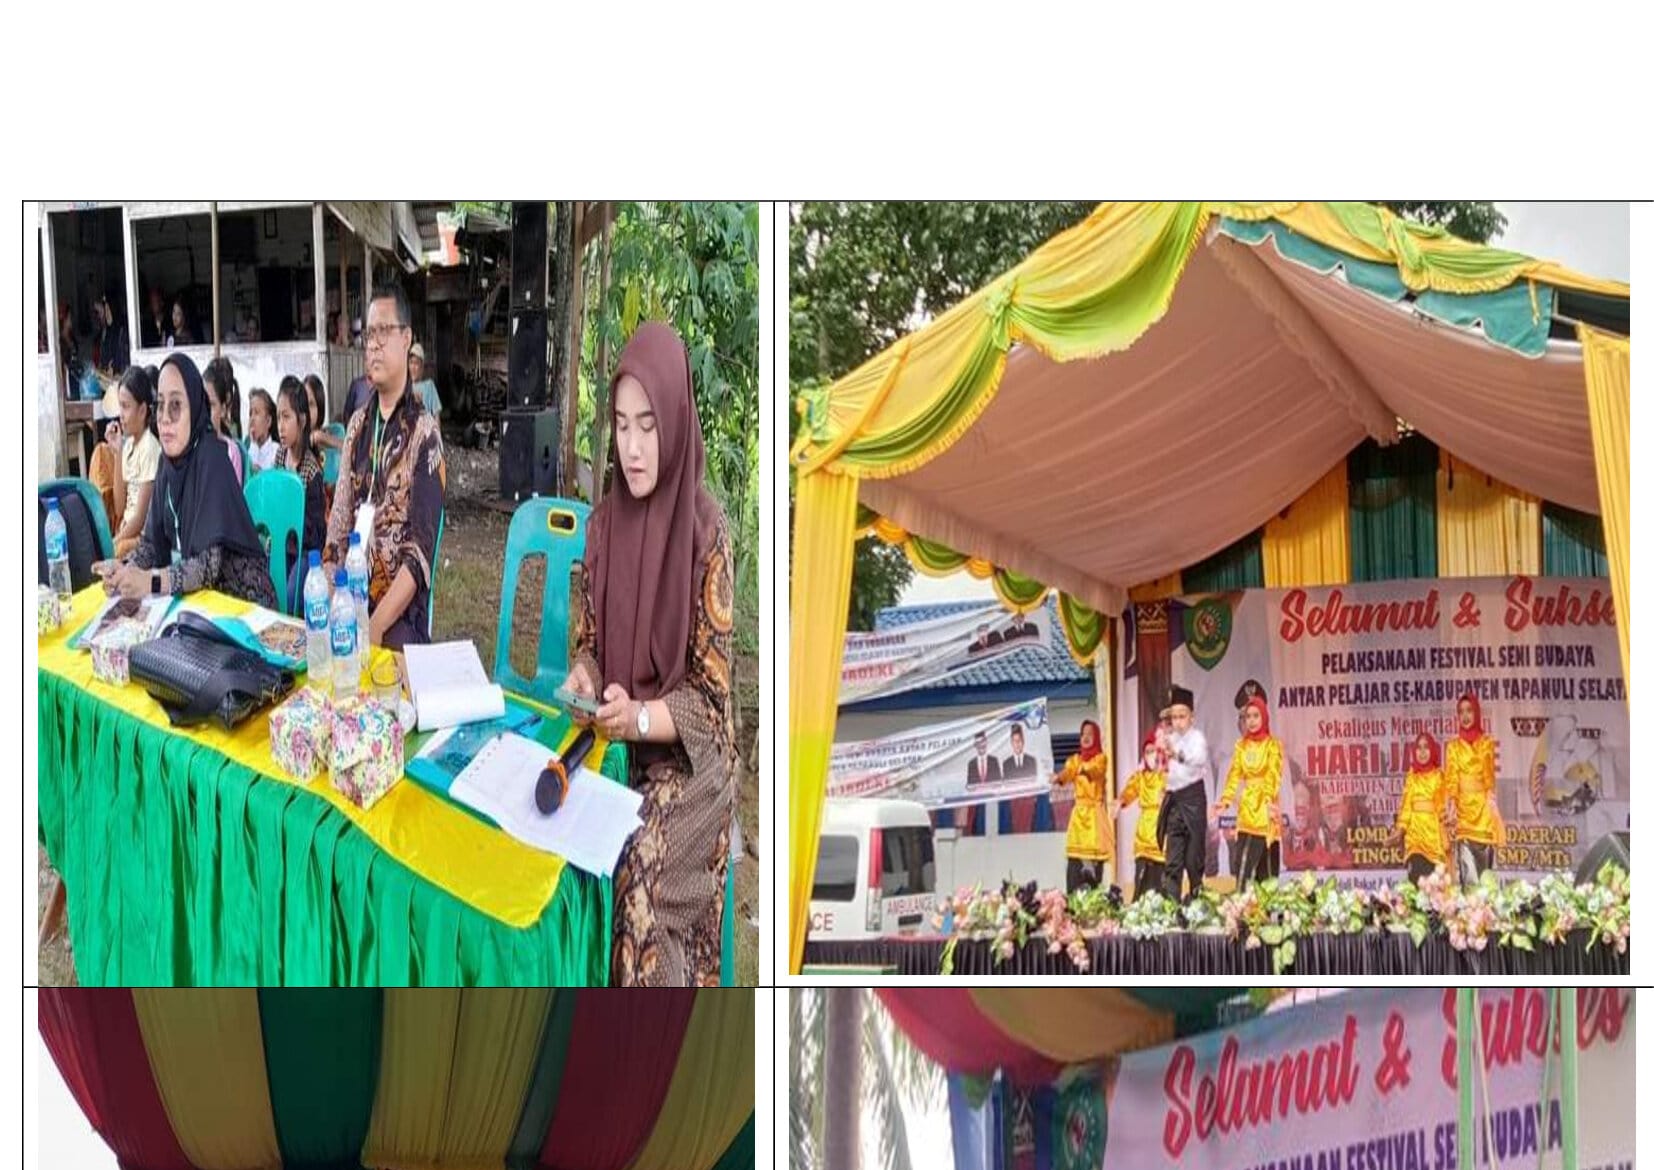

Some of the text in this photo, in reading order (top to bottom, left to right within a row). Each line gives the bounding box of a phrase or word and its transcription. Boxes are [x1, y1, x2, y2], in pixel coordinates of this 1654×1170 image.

[1280, 575, 1617, 642] Selamat & Sukse
[1322, 645, 1595, 675] PELAKSANAAN FESTIVAL SENI BUDAYA
[1278, 686, 1325, 708] ANTAR
[1329, 683, 1390, 706] PELAJAR
[1502, 678, 1575, 700] TAPANULI
[1578, 678, 1627, 700] SELAT
[1318, 717, 1387, 739] Sekaligus
[1307, 743, 1379, 777] HARI
[1347, 826, 1576, 844] LOMB DAERAH
[1352, 848, 1402, 865] TINGK
[1497, 850, 1529, 866] SMP
[1163, 1015, 1359, 1158] Selamat
[1375, 1012, 1412, 1095] &
